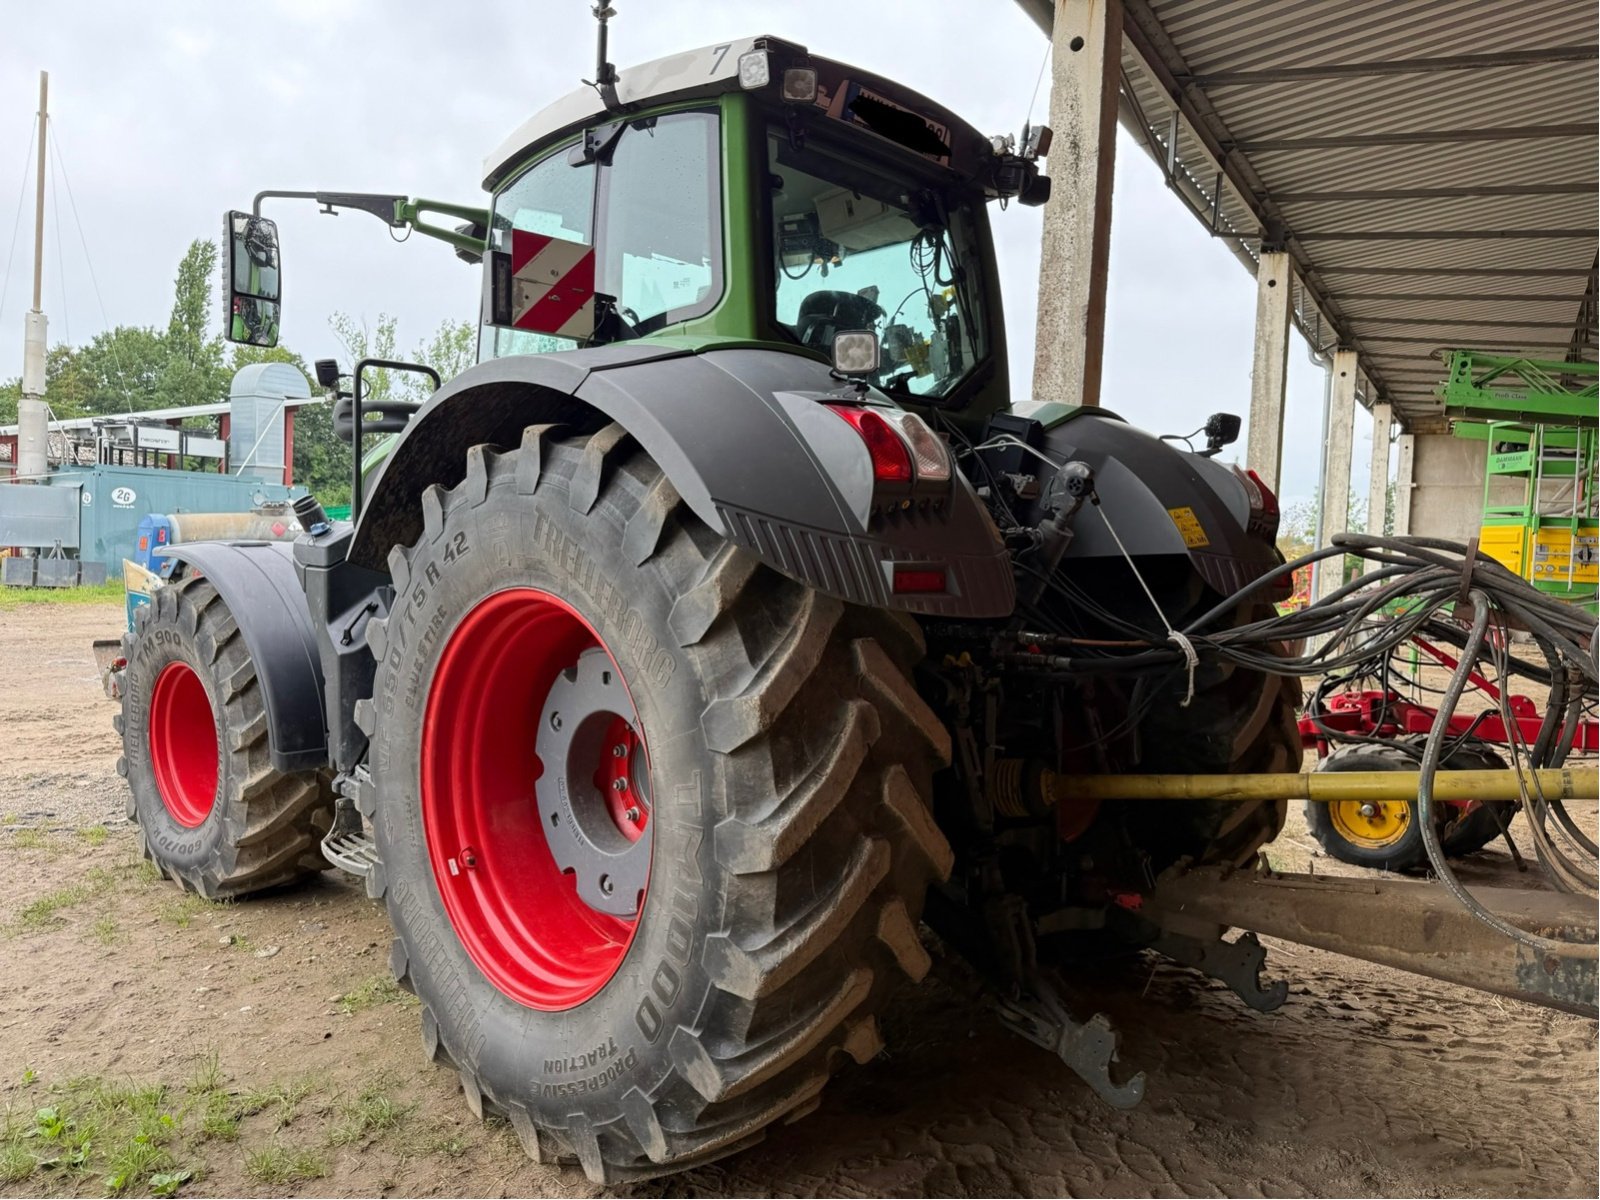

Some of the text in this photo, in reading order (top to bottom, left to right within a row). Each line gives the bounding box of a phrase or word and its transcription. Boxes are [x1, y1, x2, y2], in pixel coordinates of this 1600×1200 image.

[710, 44, 732, 76] 7
[117, 489, 131, 503] 2G
[424, 561, 442, 589] R
[442, 530, 471, 566] 42
[530, 504, 677, 689] TRELLEBORG
[129, 672, 141, 770] TRELLEBORG
[633, 769, 705, 1046] TM1000
[530, 1045, 641, 1098] PROGRESSIVE
[543, 1036, 620, 1074] TRACTION
